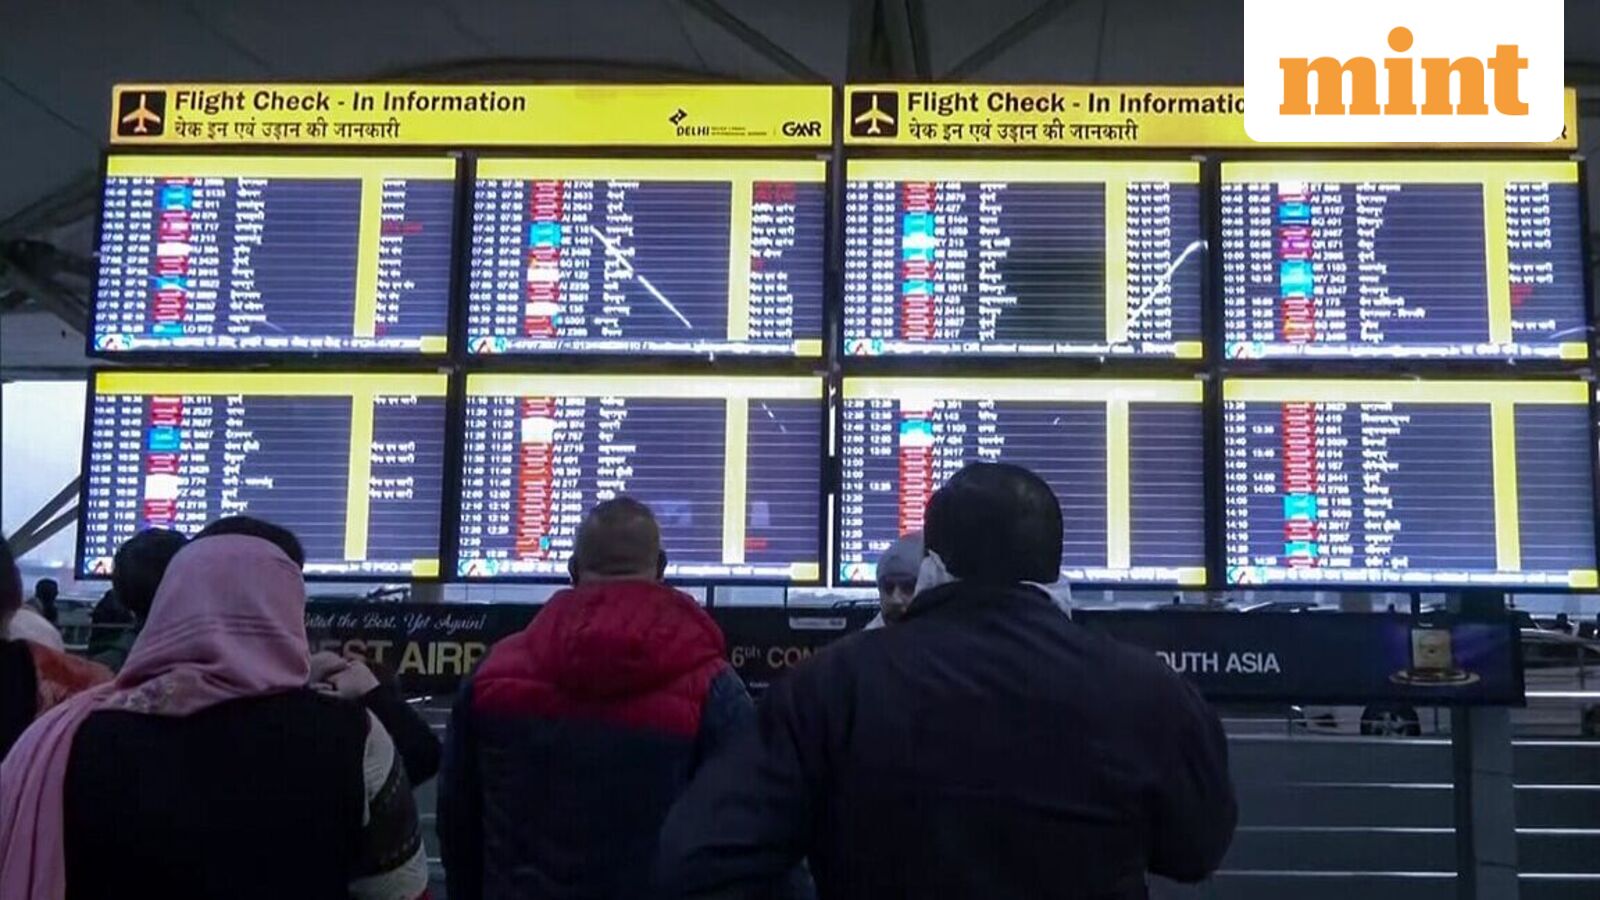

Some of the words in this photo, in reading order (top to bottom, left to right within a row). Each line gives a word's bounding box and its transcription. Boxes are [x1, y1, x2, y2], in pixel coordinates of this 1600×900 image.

[175, 91, 244, 114] Flight
[253, 91, 330, 111] Check
[353, 92, 374, 111] In
[384, 91, 526, 111] Information
[908, 92, 978, 116] Flight
[987, 92, 1065, 113] Check
[1088, 92, 1110, 113] In
[1129, 92, 1244, 113] Informatio
[207, 121, 228, 139] इन
[234, 117, 255, 138] एवं
[306, 117, 326, 138] की
[334, 117, 400, 138] जानकारी
[677, 125, 710, 137] DELHI
[782, 121, 822, 137] GMR
[943, 122, 963, 140] इन
[969, 118, 991, 138] एवं
[1043, 118, 1064, 139] की
[1070, 118, 1139, 140] जानकारी
[400, 641, 487, 676] AIRP
[1225, 652, 1281, 674] ASIA
